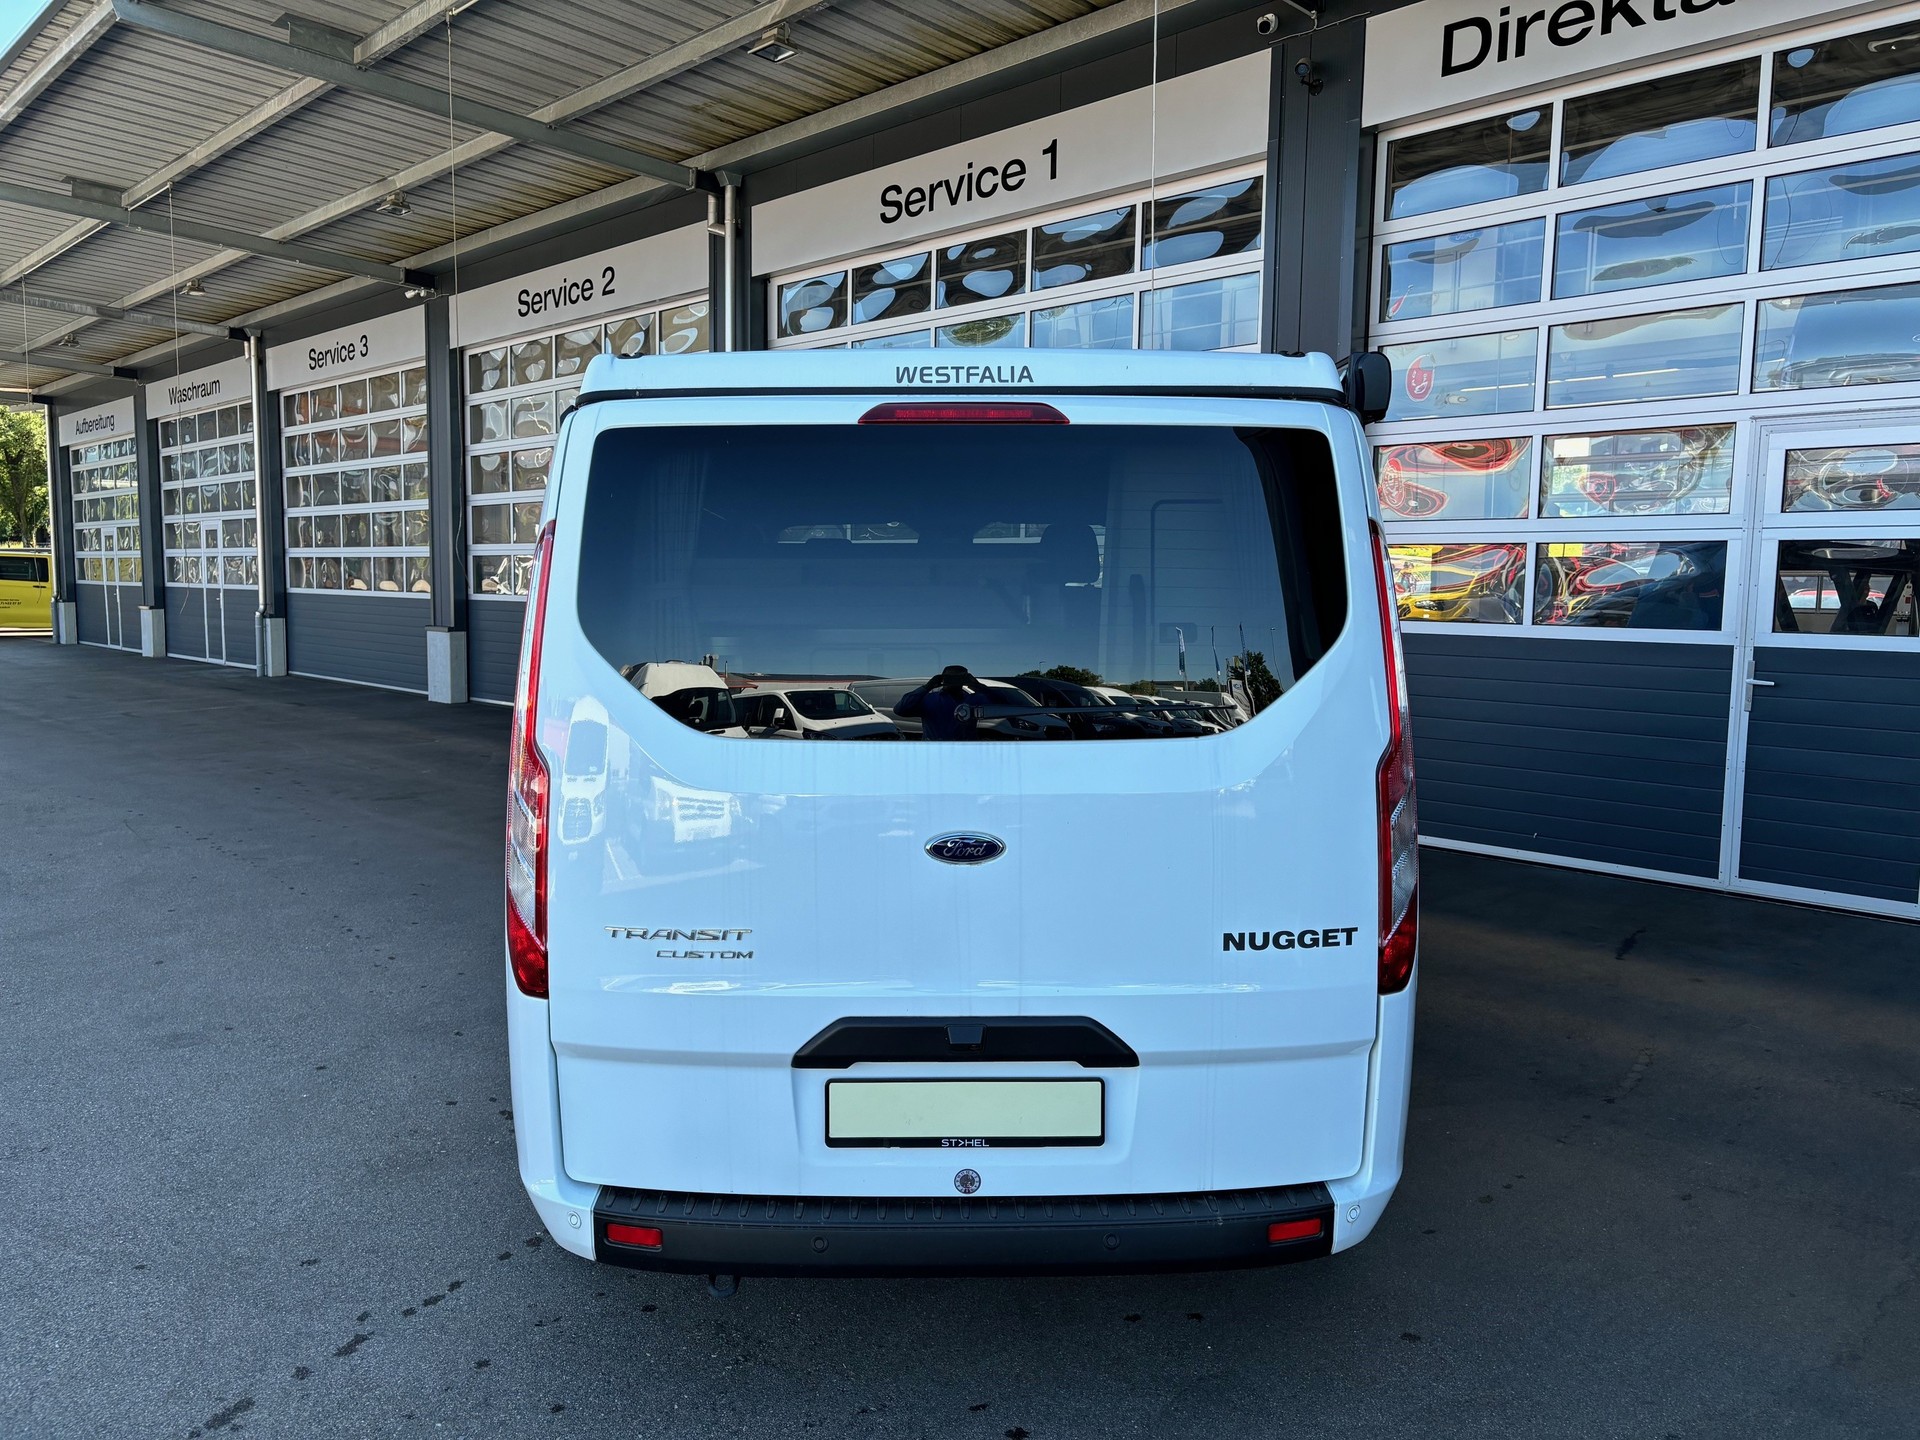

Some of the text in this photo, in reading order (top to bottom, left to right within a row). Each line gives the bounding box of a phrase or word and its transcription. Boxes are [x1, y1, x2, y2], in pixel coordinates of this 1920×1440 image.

[1441, 0, 1738, 77] Direk
[880, 138, 1058, 224] Service 1
[517, 266, 615, 317] Service 2
[308, 334, 369, 370] Service 3
[896, 365, 1035, 384] WESTFALIA
[168, 379, 221, 405] Waschraum
[75, 414, 115, 436] Aufbereitung
[943, 839, 987, 856] Ford
[604, 926, 753, 941] TRANSIT
[1222, 926, 1359, 951] NUGGET
[656, 950, 754, 959] CUSTOM
